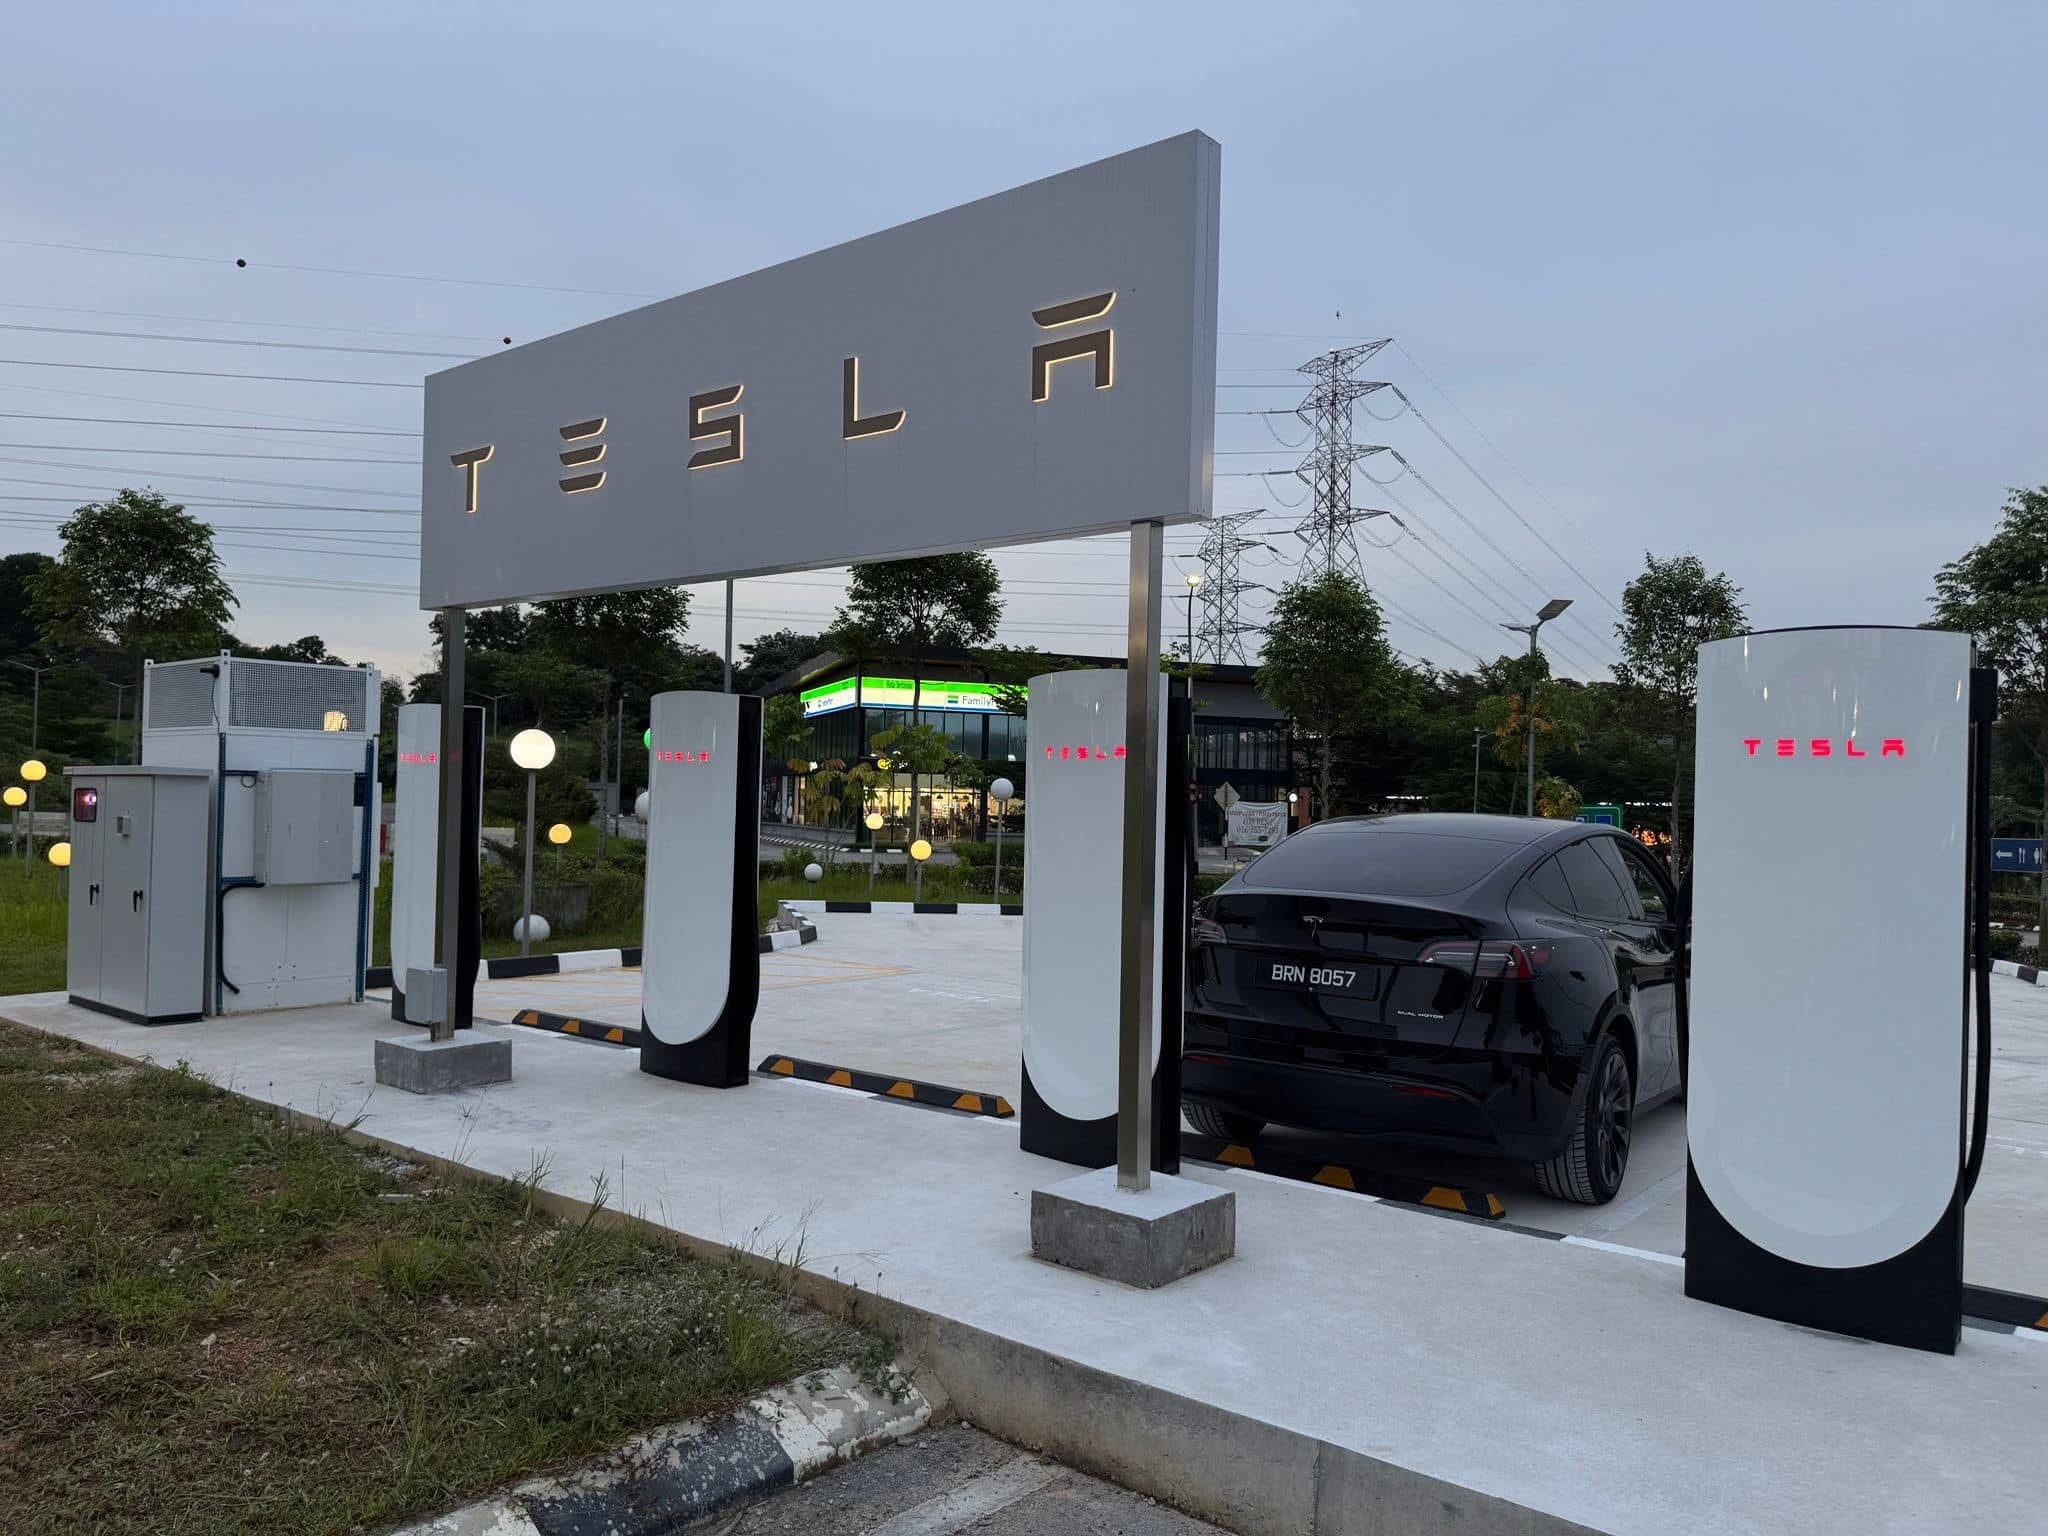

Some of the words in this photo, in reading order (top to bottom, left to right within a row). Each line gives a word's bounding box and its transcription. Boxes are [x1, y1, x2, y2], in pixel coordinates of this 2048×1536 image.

[450, 290, 1117, 513] TESLA
[962, 695, 994, 707] Family
[656, 751, 710, 764] TESLA
[1045, 744, 1128, 761] TESLA
[1743, 738, 1908, 760] TESLA
[1271, 963, 1305, 983] BRN
[1309, 967, 1356, 988] 8057
[1418, 1012, 1444, 1020] MOTOR
